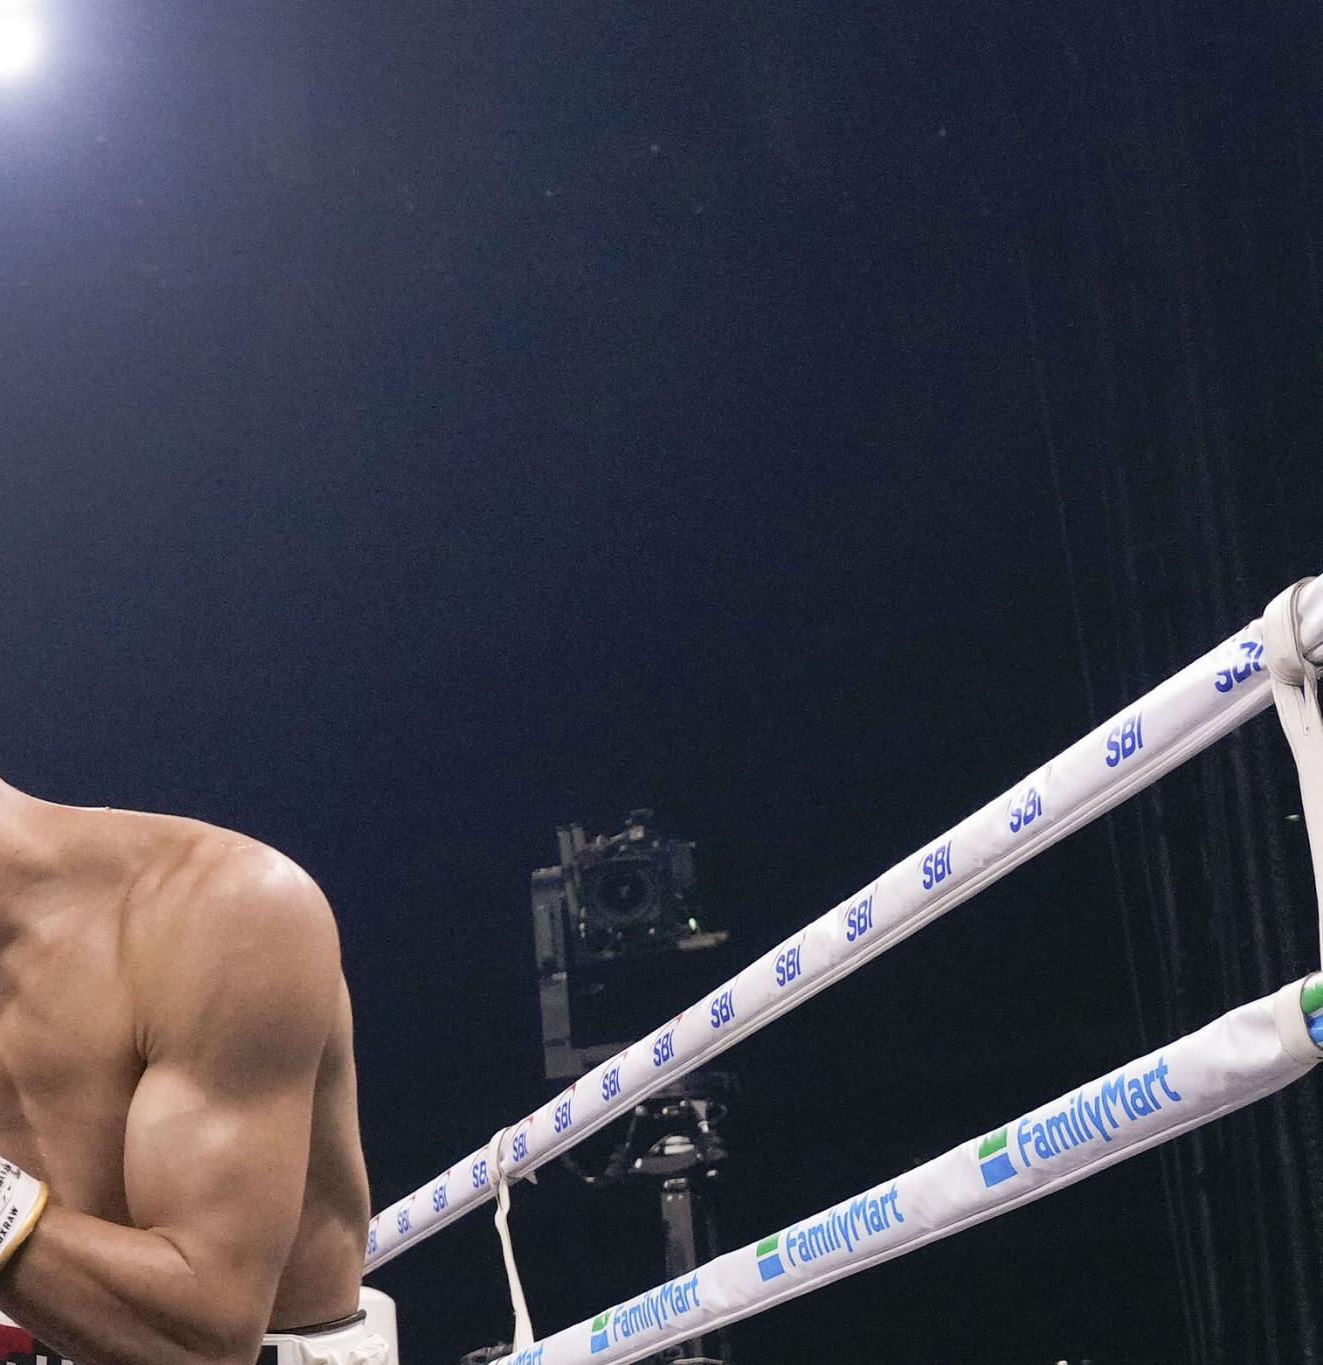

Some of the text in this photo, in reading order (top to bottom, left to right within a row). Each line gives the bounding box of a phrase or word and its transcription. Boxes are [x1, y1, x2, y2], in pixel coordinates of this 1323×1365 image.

[1106, 711, 1143, 768] SBI
[1009, 786, 1043, 833] SBI
[922, 840, 952, 890] SBI
[846, 893, 875, 942] SBI
[775, 944, 802, 988] SBI
[710, 989, 735, 1030] SBI
[653, 1029, 675, 1067] SBI
[601, 1067, 622, 1101] SBI
[554, 1102, 573, 1134] SBI
[1016, 1056, 1182, 1168] FamilyMart
[512, 1131, 529, 1162] SBI
[472, 1160, 489, 1188] SB
[784, 1183, 905, 1268] FamilyMart
[612, 1273, 700, 1343] FamilyMart
